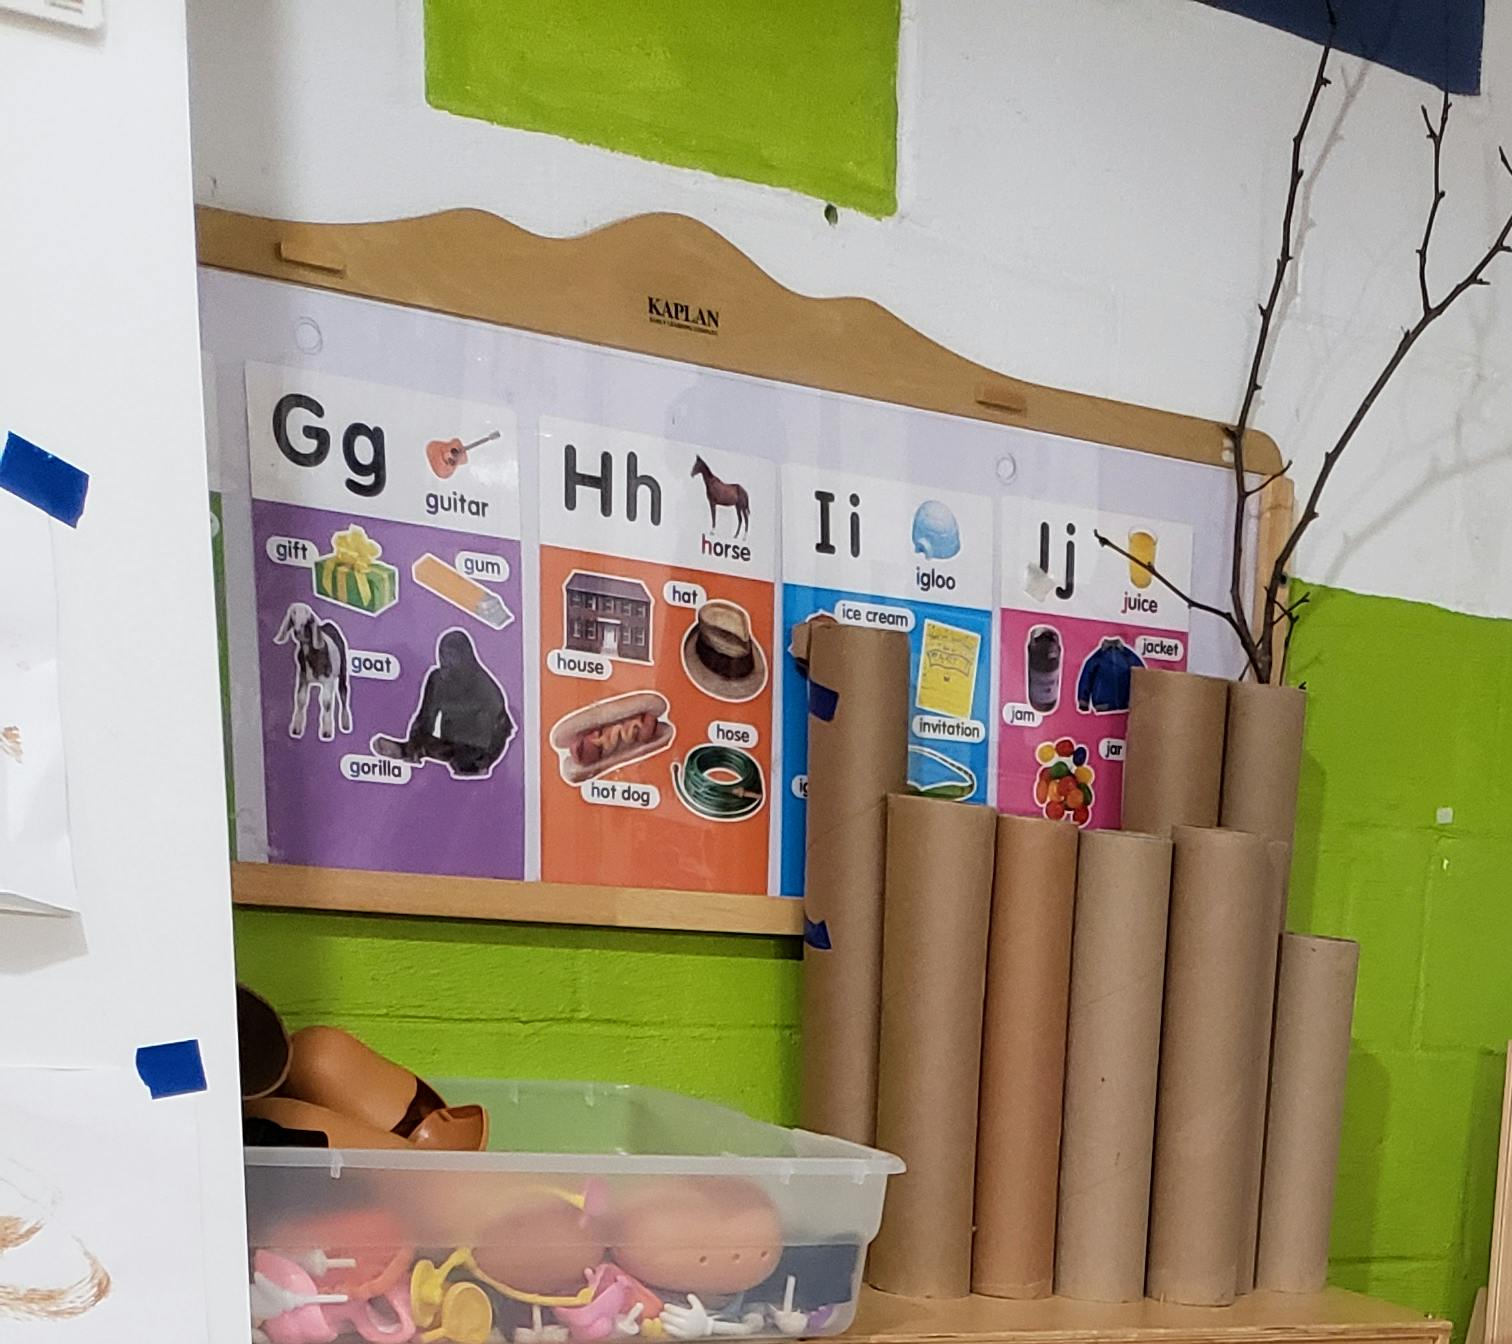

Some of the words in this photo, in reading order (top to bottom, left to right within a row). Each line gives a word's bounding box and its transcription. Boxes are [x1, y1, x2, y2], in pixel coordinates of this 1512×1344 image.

[648, 296, 719, 329] KAPLAN
[273, 393, 387, 497] Gg
[564, 444, 661, 526] Hh
[425, 491, 489, 517] guitar
[276, 541, 308, 561] gift
[701, 534, 751, 561] horse
[464, 557, 501, 575] gum
[916, 568, 956, 591] igloo
[672, 586, 697, 604] hat
[1121, 592, 1158, 614] juice
[842, 604, 861, 621] ice
[866, 610, 908, 627] cream
[1142, 639, 1179, 656] jacket
[351, 656, 391, 673] goat
[557, 653, 604, 674] house
[1010, 707, 1035, 723] jam
[716, 725, 750, 743] hose
[919, 717, 980, 739] invitation
[1106, 741, 1123, 757] jar
[350, 760, 402, 778] gorilla
[591, 782, 616, 799] hot
[622, 786, 650, 806] dog
